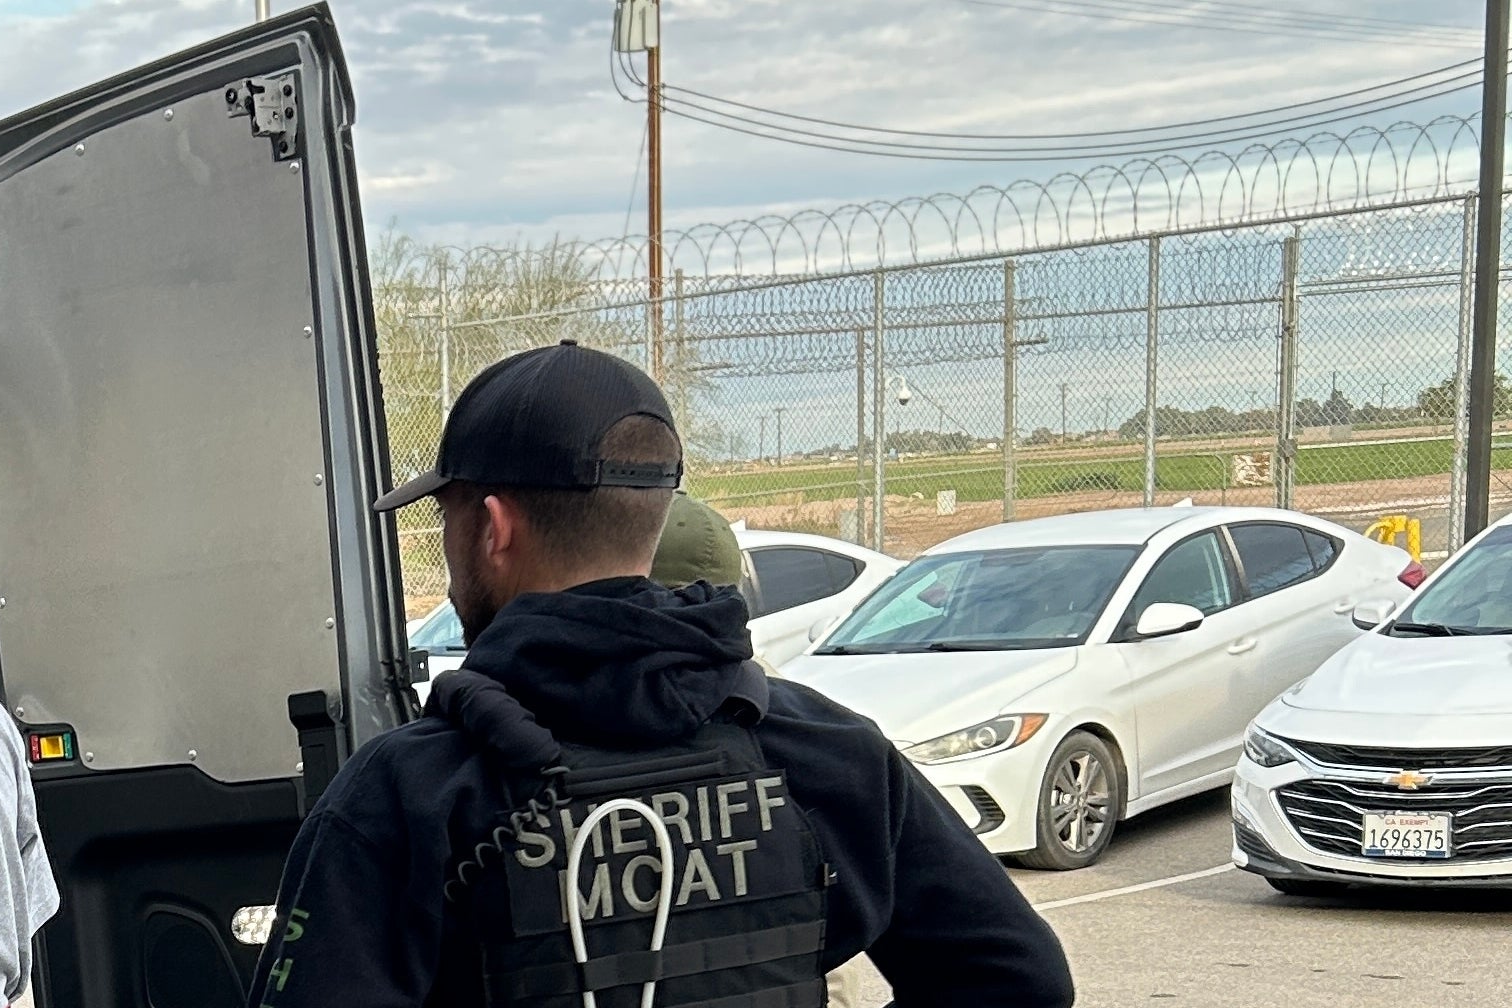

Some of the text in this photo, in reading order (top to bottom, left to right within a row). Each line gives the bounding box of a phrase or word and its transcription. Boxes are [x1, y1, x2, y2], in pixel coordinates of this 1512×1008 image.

[511, 777, 785, 868] SHERIFF
[1369, 829, 1444, 849] 1696375
[1385, 818, 1396, 826] CA
[558, 840, 757, 923] MCAT
